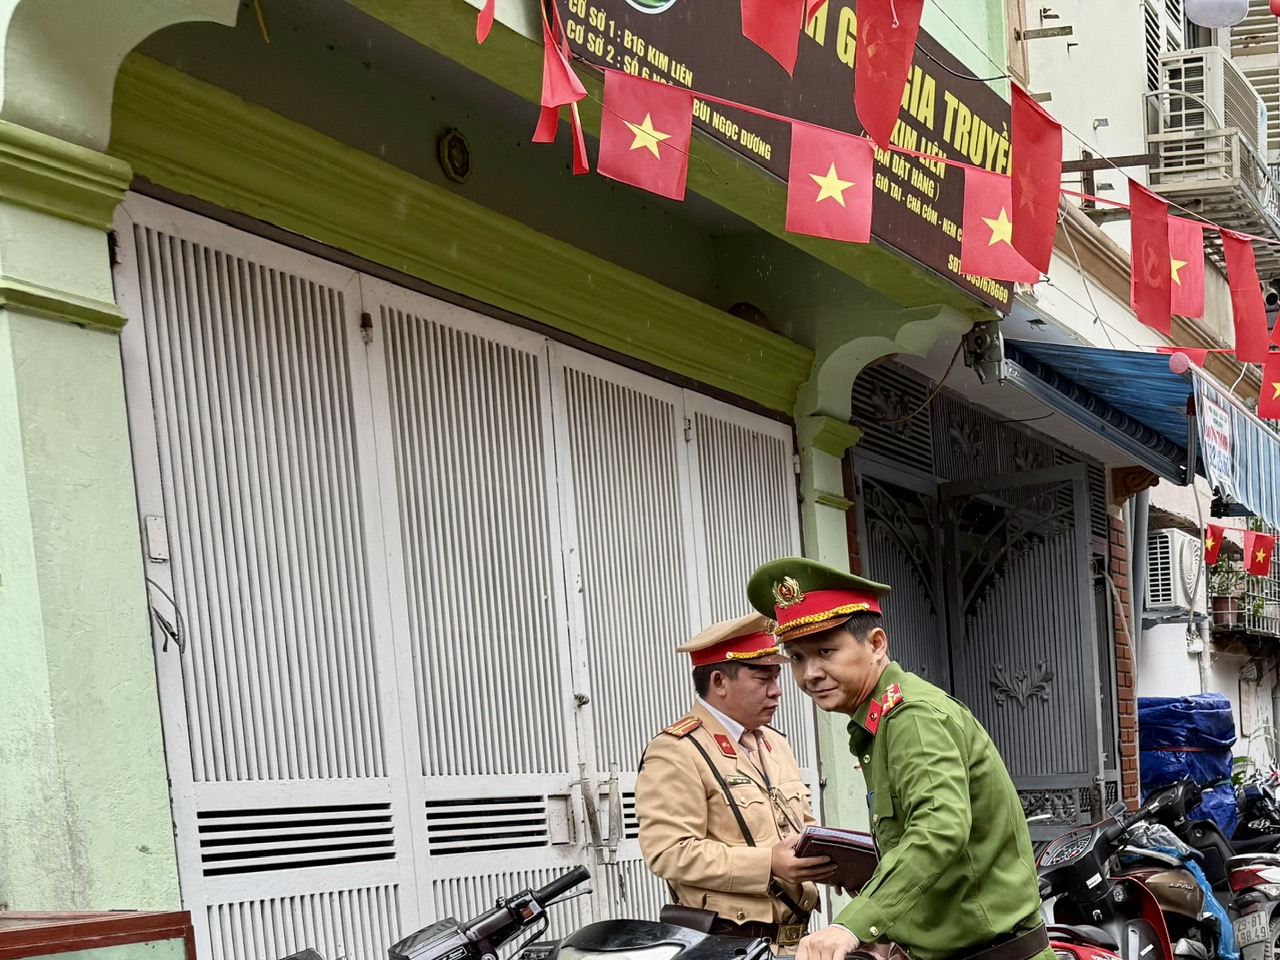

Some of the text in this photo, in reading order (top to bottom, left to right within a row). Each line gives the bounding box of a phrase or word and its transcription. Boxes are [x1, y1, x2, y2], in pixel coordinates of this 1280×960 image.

[566, 19, 586, 45] CƠ
[605, 44, 615, 64] 2
[608, 20, 615, 38] 1
[623, 29, 646, 57] B16
[647, 45, 669, 74] KIM
[671, 63, 693, 89] LIÊN
[692, 98, 772, 160] BÙI NGỌC DƯƠNG
[943, 89, 1012, 177] TRUYỀ
[890, 182, 903, 202] TAI
[942, 217, 957, 239] NEM
[911, 166, 935, 199] HÀNG
[1236, 914, 1262, 933] 29-B1
